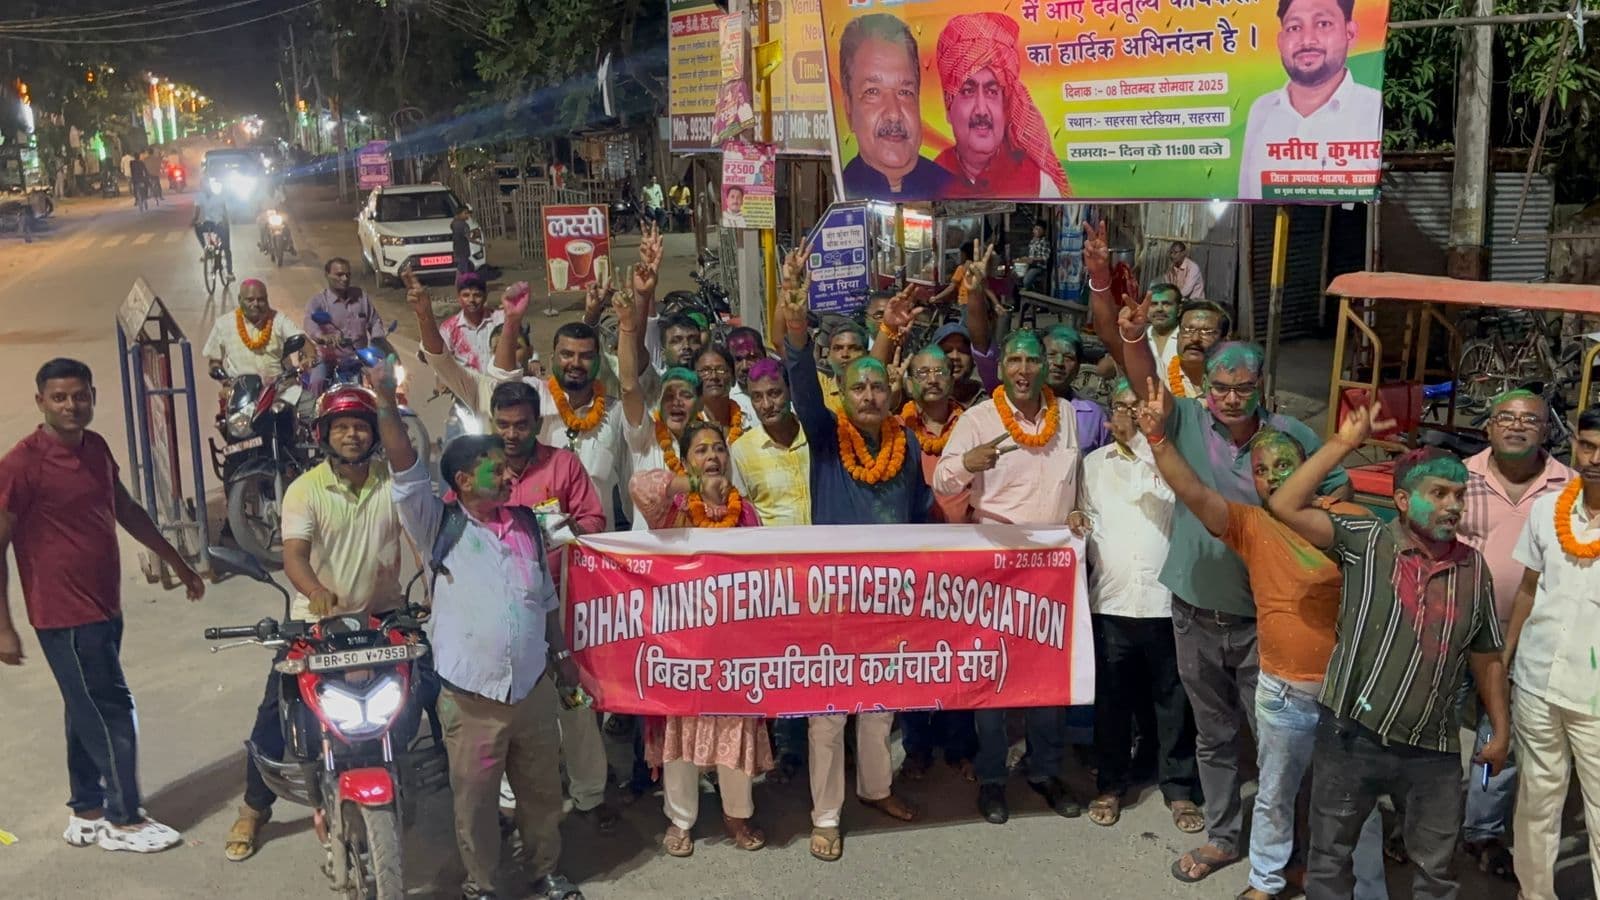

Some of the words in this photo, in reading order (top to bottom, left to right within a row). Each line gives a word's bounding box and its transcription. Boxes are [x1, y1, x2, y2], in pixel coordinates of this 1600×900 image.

[1047, 1, 1084, 22] आए
[1027, 44, 1051, 64] का
[1058, 32, 1115, 64] हार्दिक
[1123, 28, 1213, 58] अभिनंदन
[1217, 18, 1238, 53] है
[1106, 86, 1117, 97] 08
[1120, 80, 1155, 96] सितम्बर
[1158, 78, 1194, 94] सोमवार
[1198, 79, 1224, 92] 2025
[1104, 115, 1137, 127] सहरसा
[1188, 112, 1225, 124] सहरसा
[1119, 144, 1144, 157] दिन
[1147, 143, 1162, 156] के
[1166, 144, 1196, 156] 11:00
[1199, 142, 1223, 156] बजे
[1266, 137, 1319, 160] मनीष
[1326, 140, 1380, 166] कुमार
[546, 207, 605, 237] लस्सी
[626, 558, 653, 574] 3297
[1015, 551, 1071, 569] 25.05.1929
[574, 588, 644, 652] BIHAR
[651, 571, 801, 635] MINISTERIAL
[807, 565, 916, 620] OFFICERS
[921, 571, 1066, 651] ASSOCIATION
[717, 640, 855, 703] अनुसचिवीय
[860, 639, 953, 687] कर्मचारी
